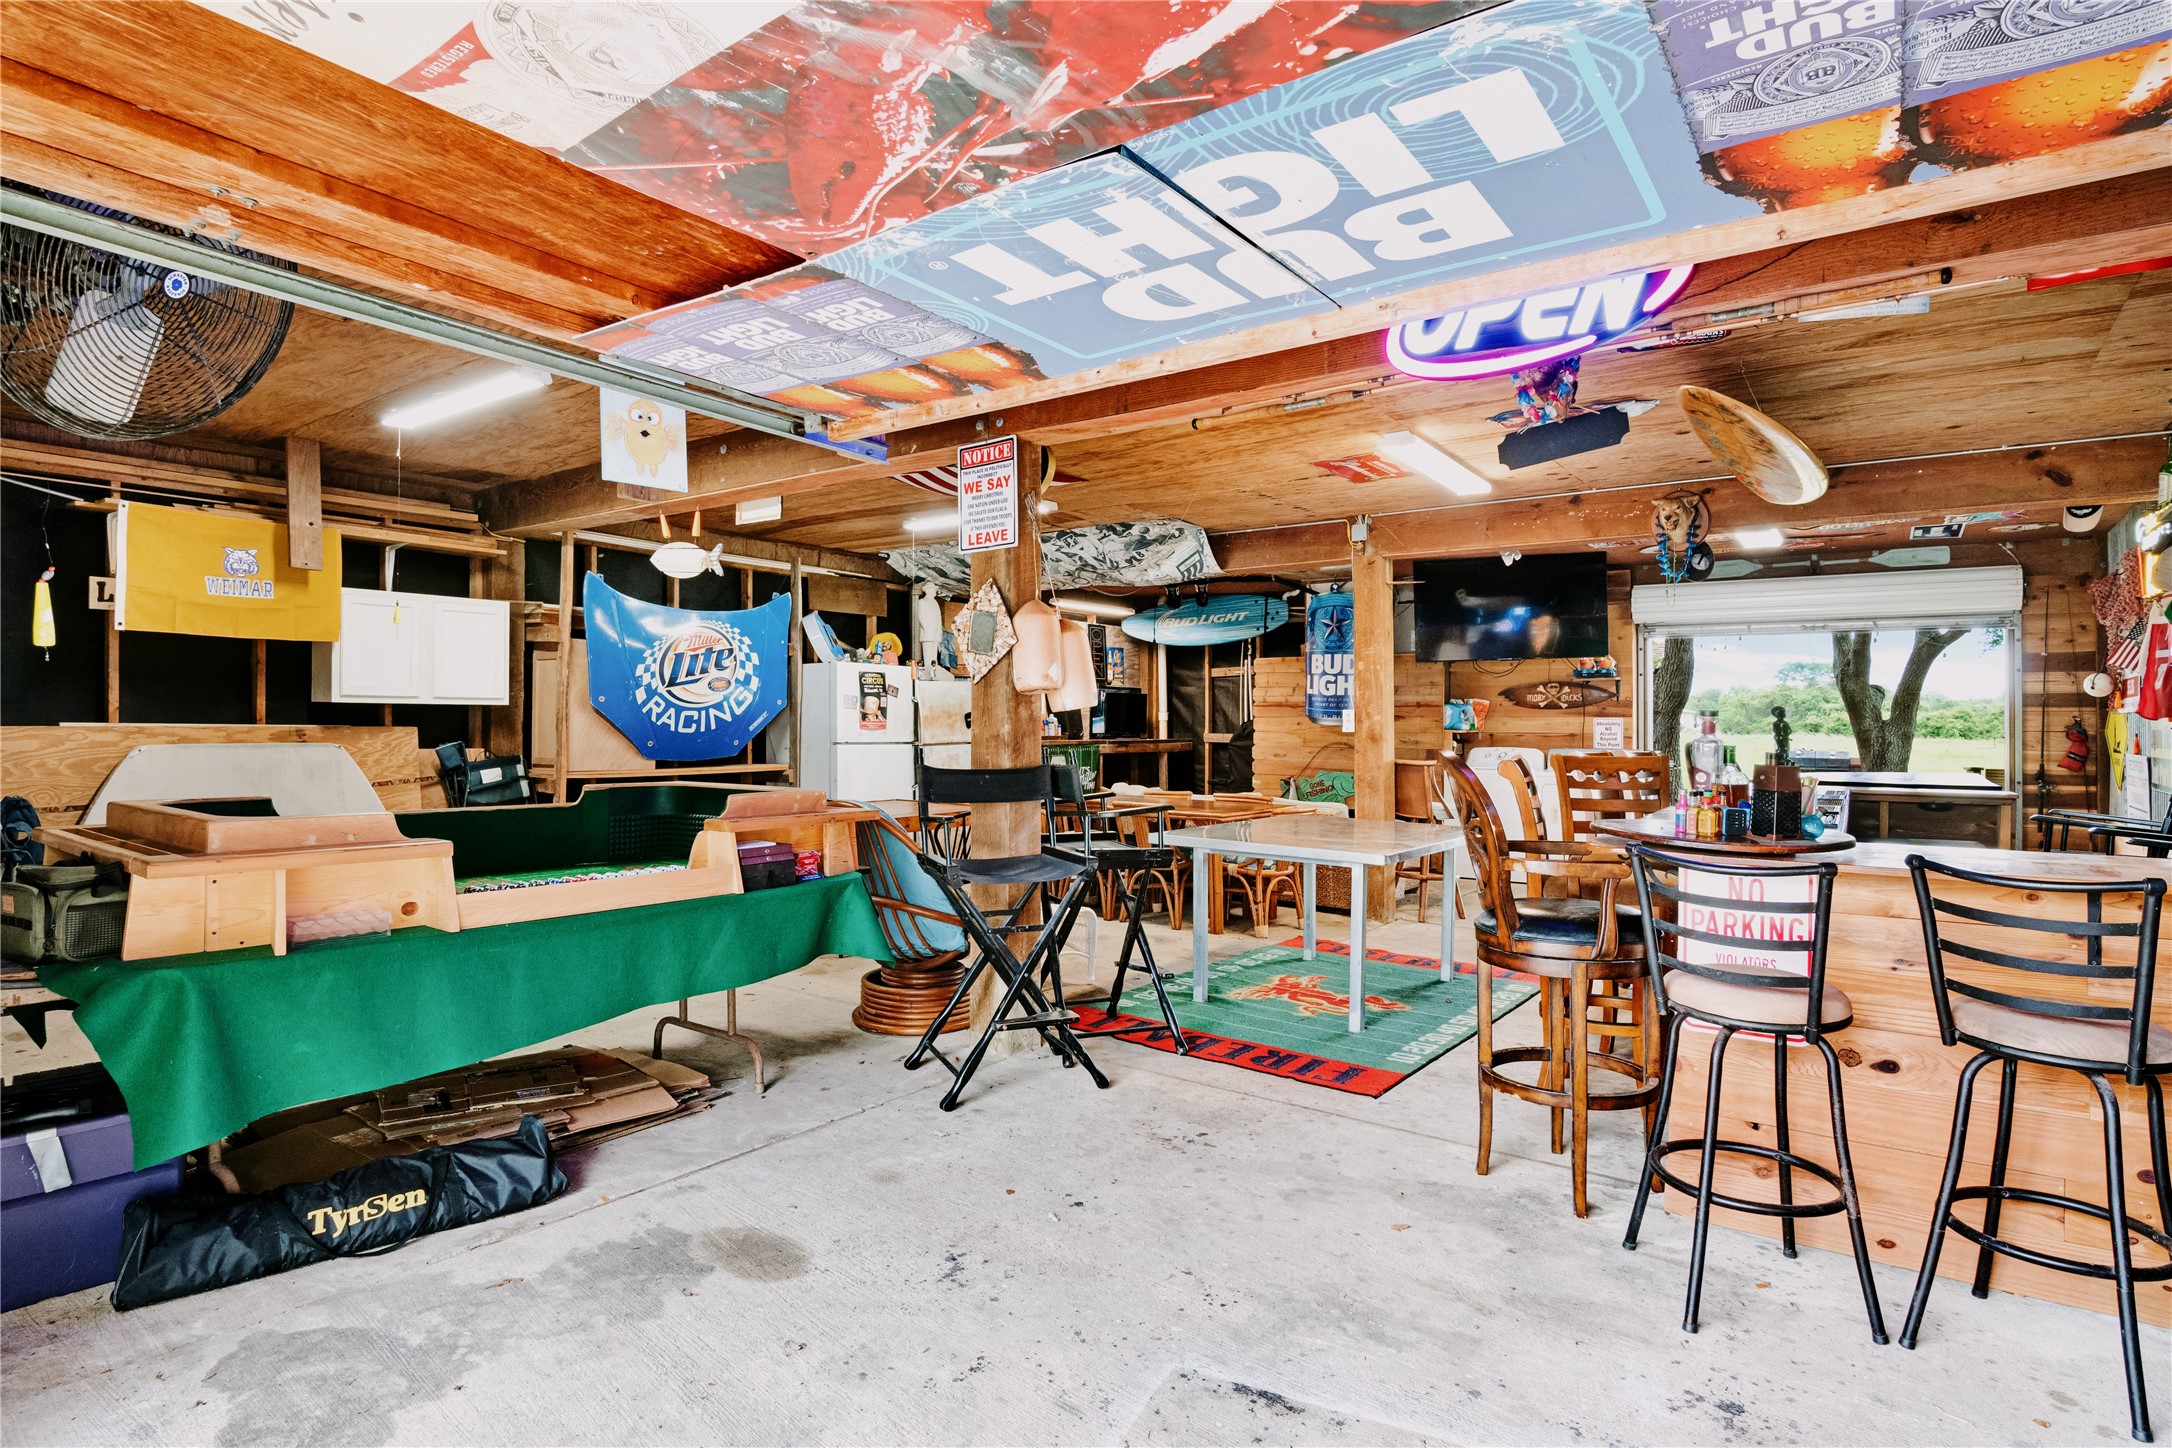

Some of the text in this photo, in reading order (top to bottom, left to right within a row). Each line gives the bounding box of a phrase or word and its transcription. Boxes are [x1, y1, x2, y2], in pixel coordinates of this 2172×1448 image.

[1735, 0, 1895, 60] BUD
[420, 39, 475, 79] REGISTERED
[1710, 64, 1762, 84] REGISTERED
[950, 66, 1565, 307] LIGHT
[1102, 180, 1514, 322] BUD
[828, 308, 897, 331] BUD
[1404, 273, 1647, 355] OPEN
[696, 316, 791, 346] LIGHT
[734, 329, 808, 350] BUD
[677, 352, 735, 370] BUD
[963, 443, 1012, 466] NOTICE
[977, 471, 998, 480] INCORRECT
[988, 463, 1012, 472] POLITICALLY
[963, 475, 1011, 495] WE SAY
[984, 491, 1004, 499] CHRISTMAS
[983, 522, 998, 530] OFFENDS
[998, 512, 1013, 520] TROOPS
[968, 529, 1008, 546] LEAVE
[206, 577, 273, 598] WEIMAR
[1163, 611, 1250, 628] BUD LIGHT
[684, 634, 723, 648] Miller
[664, 647, 734, 689] Lite
[1311, 653, 1355, 675] BUD
[861, 677, 884, 685] CIRCUS
[1306, 674, 1355, 696] LIGH
[641, 686, 754, 734] RACING
[1304, 785, 1334, 799] FISHING
[1309, 780, 1326, 790] GONE
[1728, 876, 1764, 903] NO
[1691, 908, 1804, 942] PARKING
[1715, 952, 1777, 970] VIOLATORS
[307, 1188, 427, 1239] TyrSen
